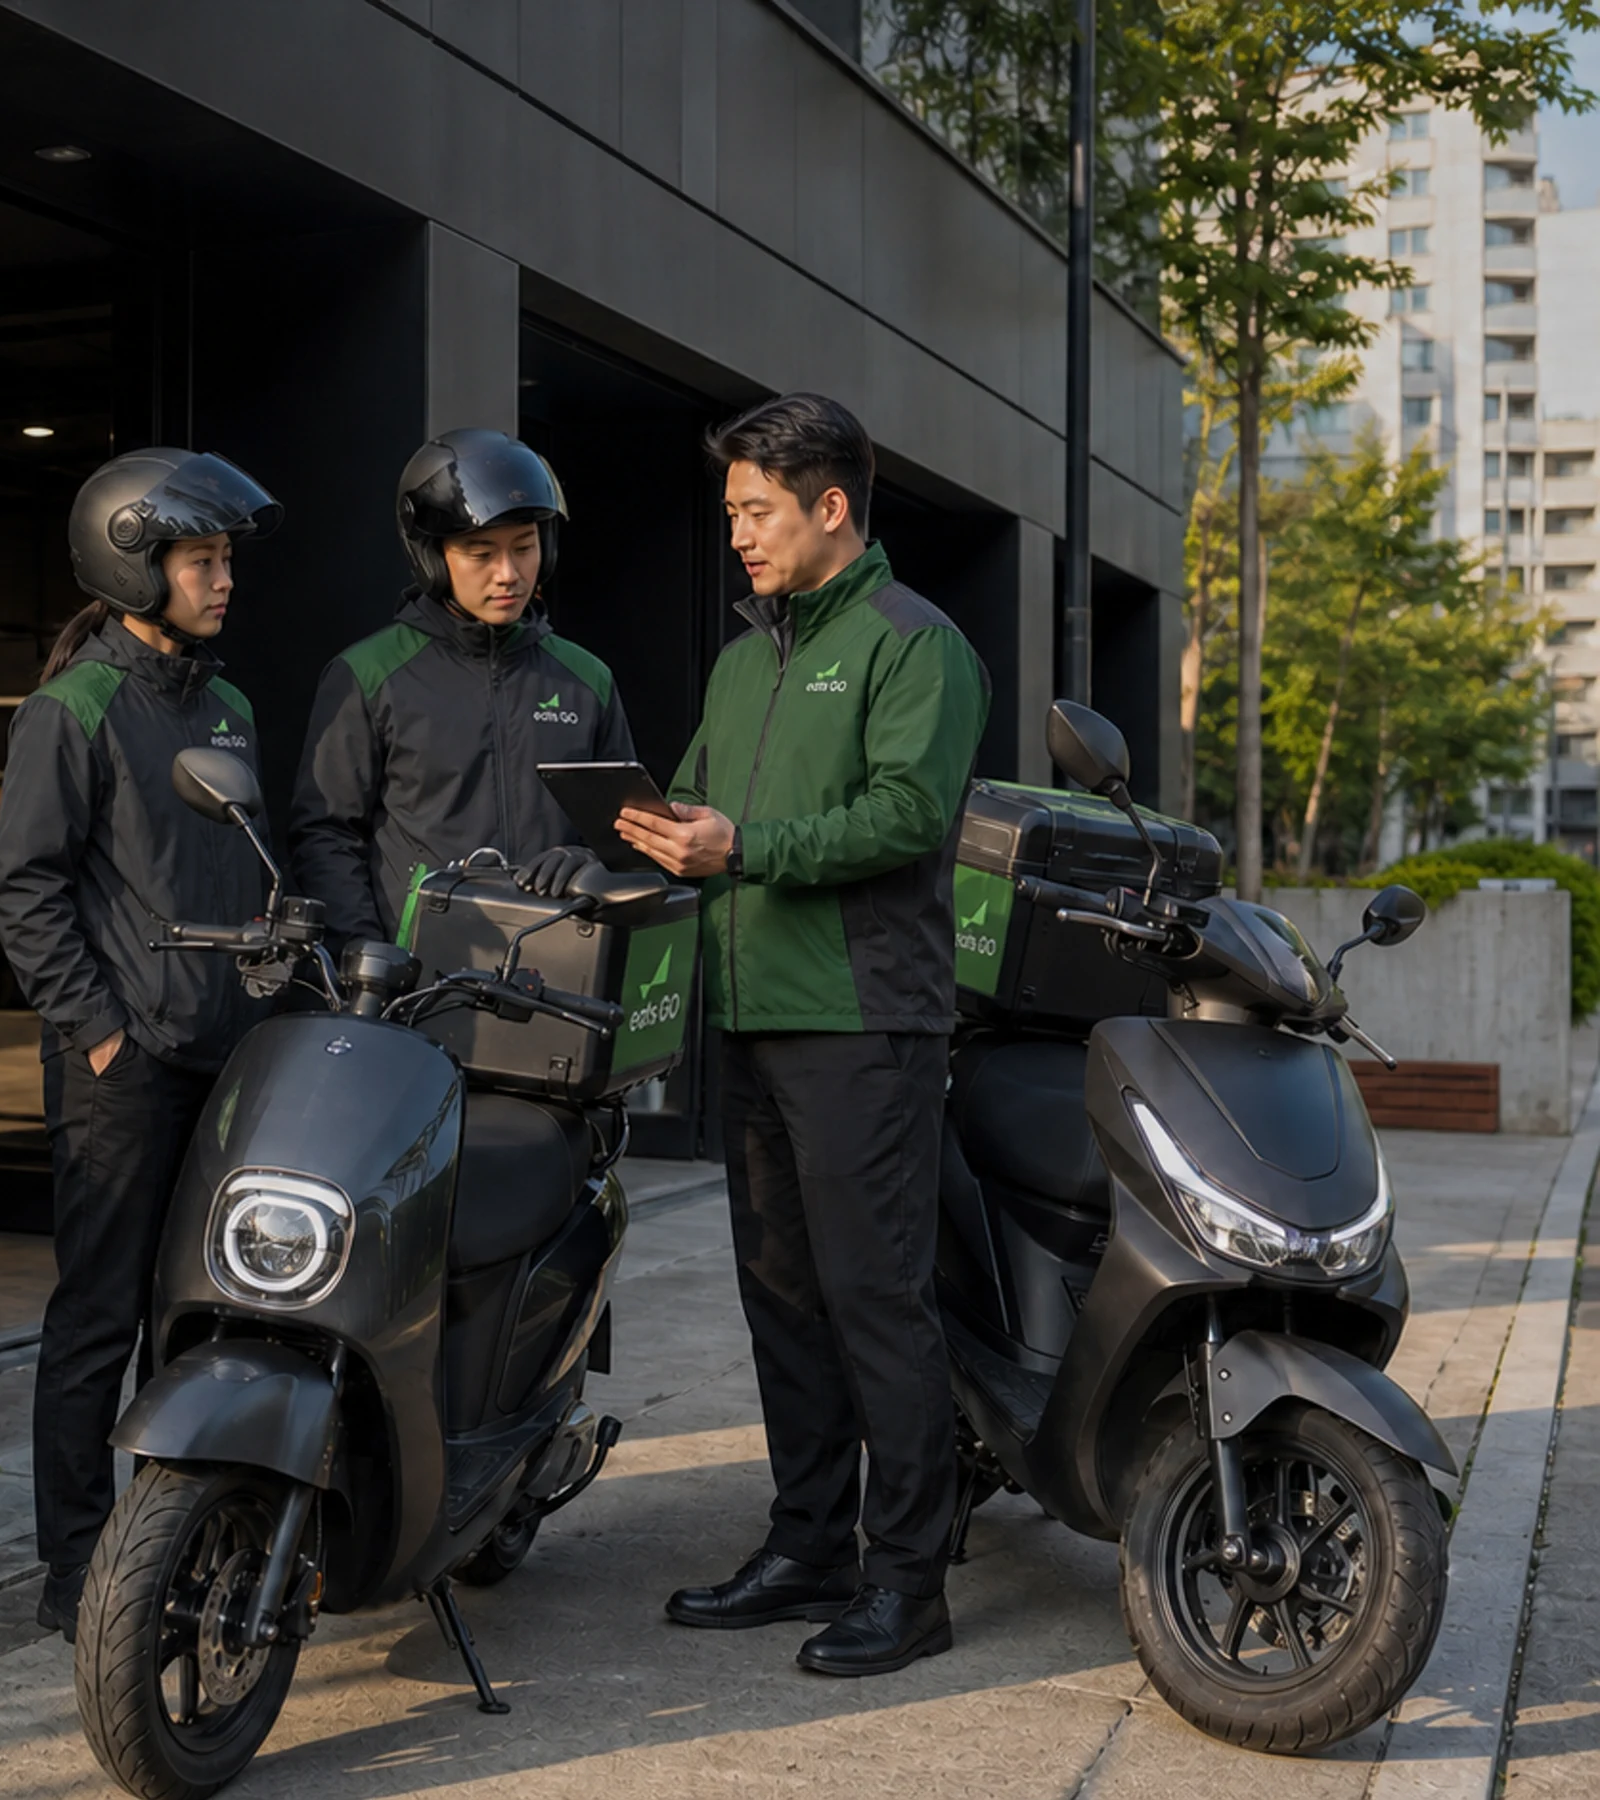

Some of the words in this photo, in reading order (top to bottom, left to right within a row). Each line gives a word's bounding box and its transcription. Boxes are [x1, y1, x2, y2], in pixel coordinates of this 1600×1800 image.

[829, 680, 847, 692] GO
[559, 711, 578, 724] GO
[977, 935, 997, 956] GO
[629, 1001, 658, 1032] eats
[659, 992, 680, 1022] GO
